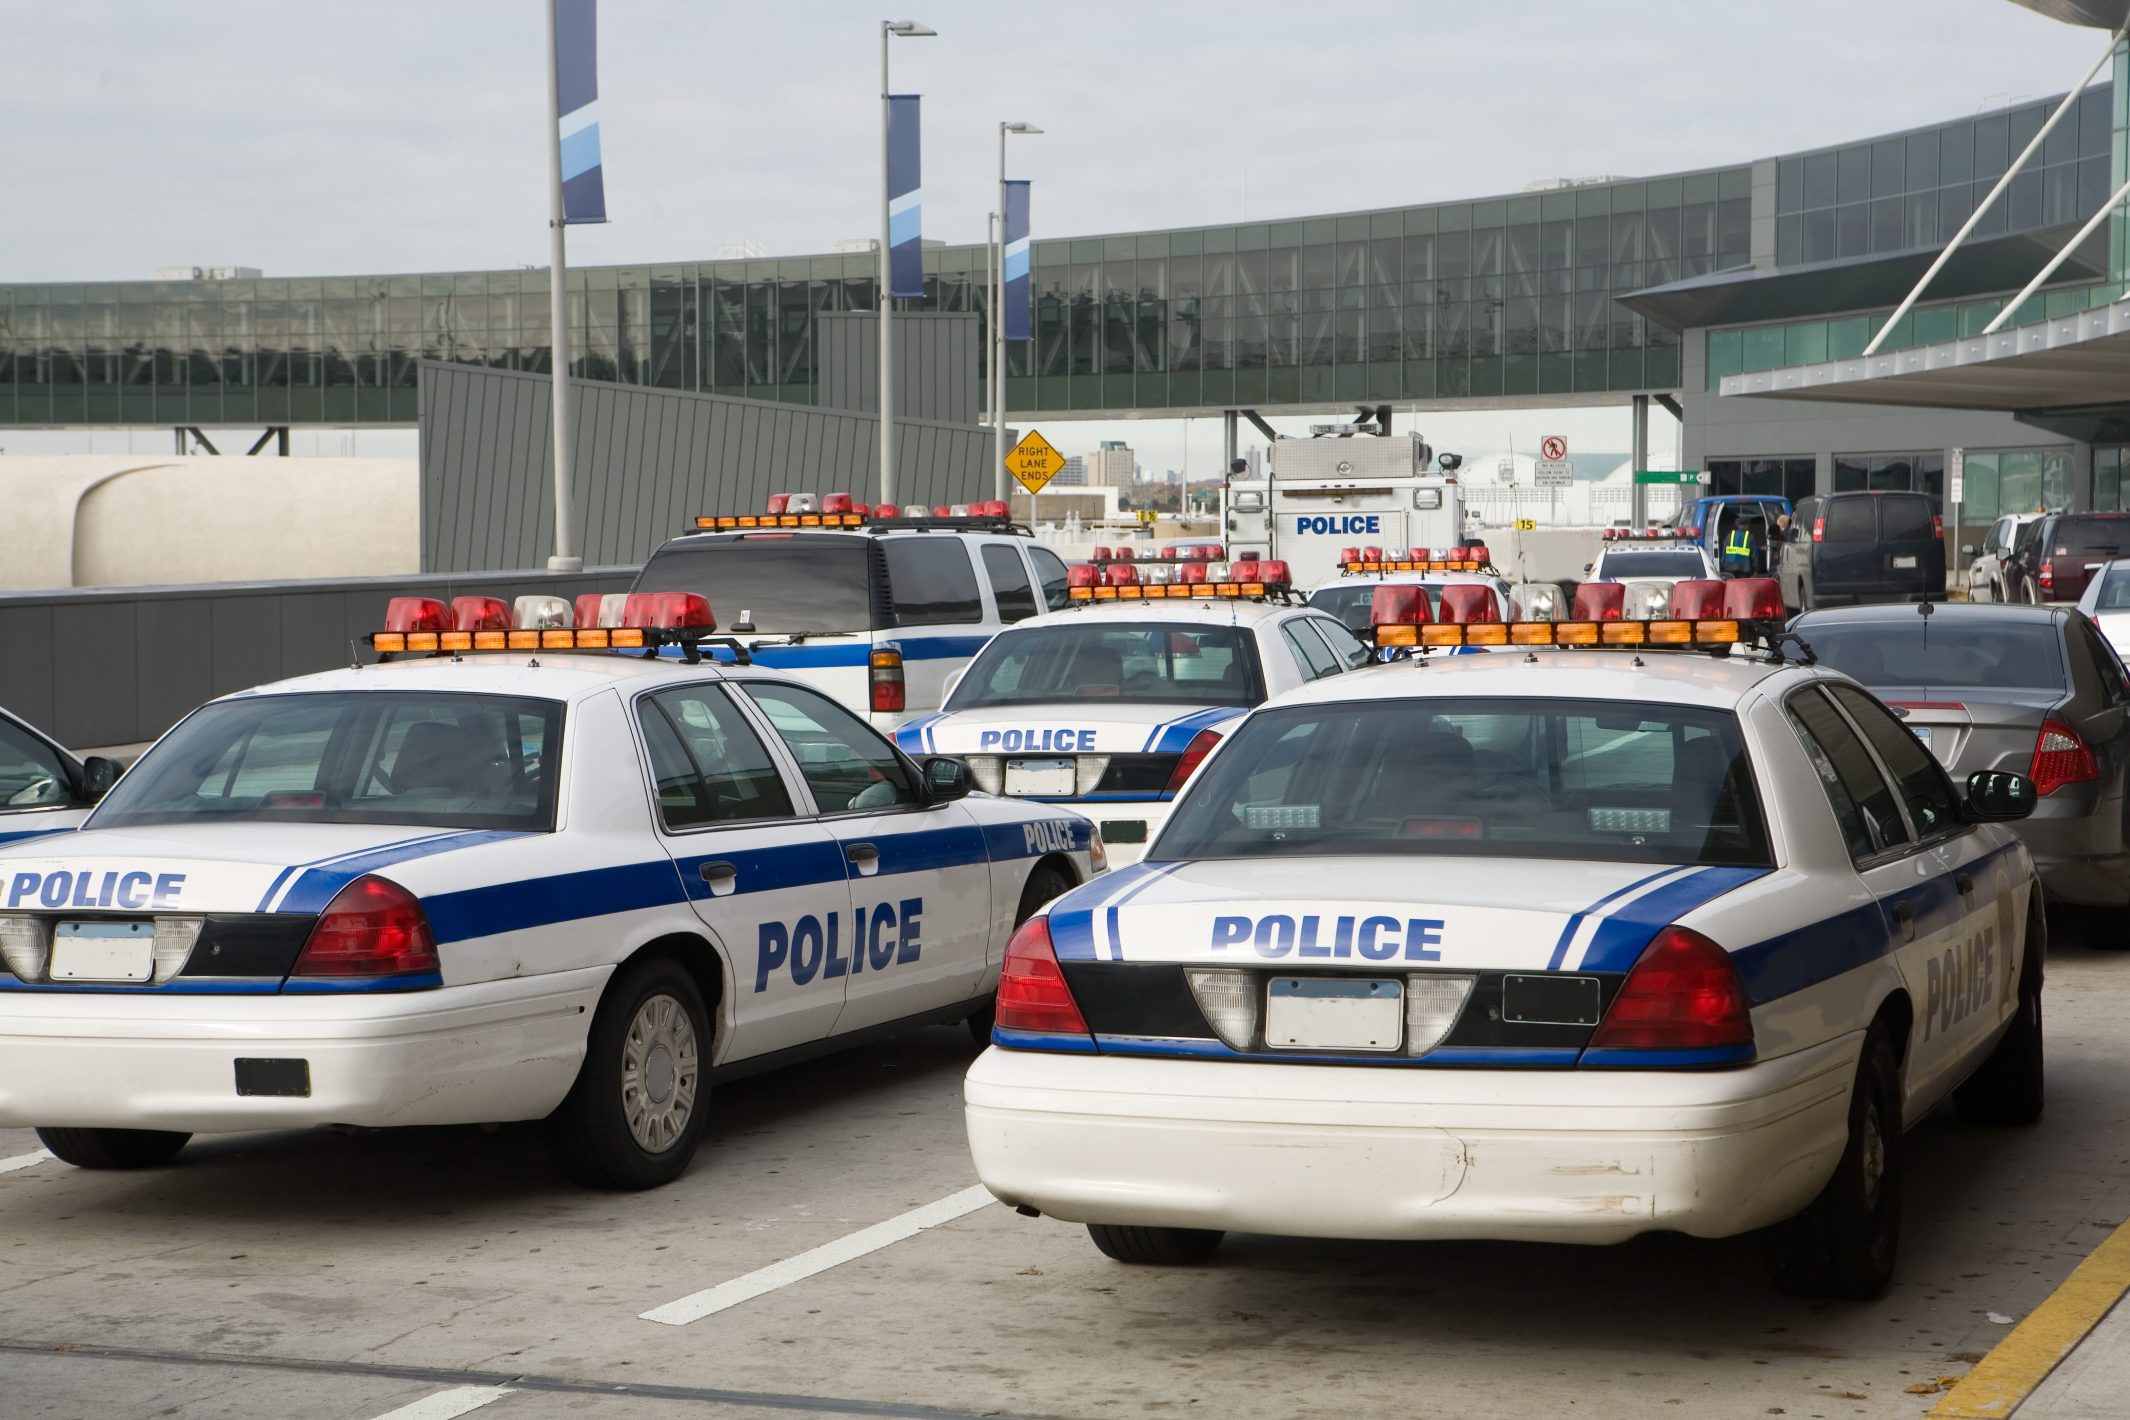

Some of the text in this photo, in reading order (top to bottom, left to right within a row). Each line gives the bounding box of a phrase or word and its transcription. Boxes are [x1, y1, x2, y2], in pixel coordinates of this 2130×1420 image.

[1018, 447, 1049, 456] RIGHT
[1020, 459, 1047, 468] LANE
[1021, 471, 1049, 480] ENDS
[1297, 516, 1379, 534] POLICE
[1520, 520, 1533, 530] 15
[980, 729, 1097, 752] POLICE
[1023, 820, 1076, 855] POLICE
[7, 871, 186, 909] POLICE
[754, 897, 923, 993] POLICE
[1210, 915, 1445, 961] POLICE
[1924, 926, 1994, 1043] POLICE
